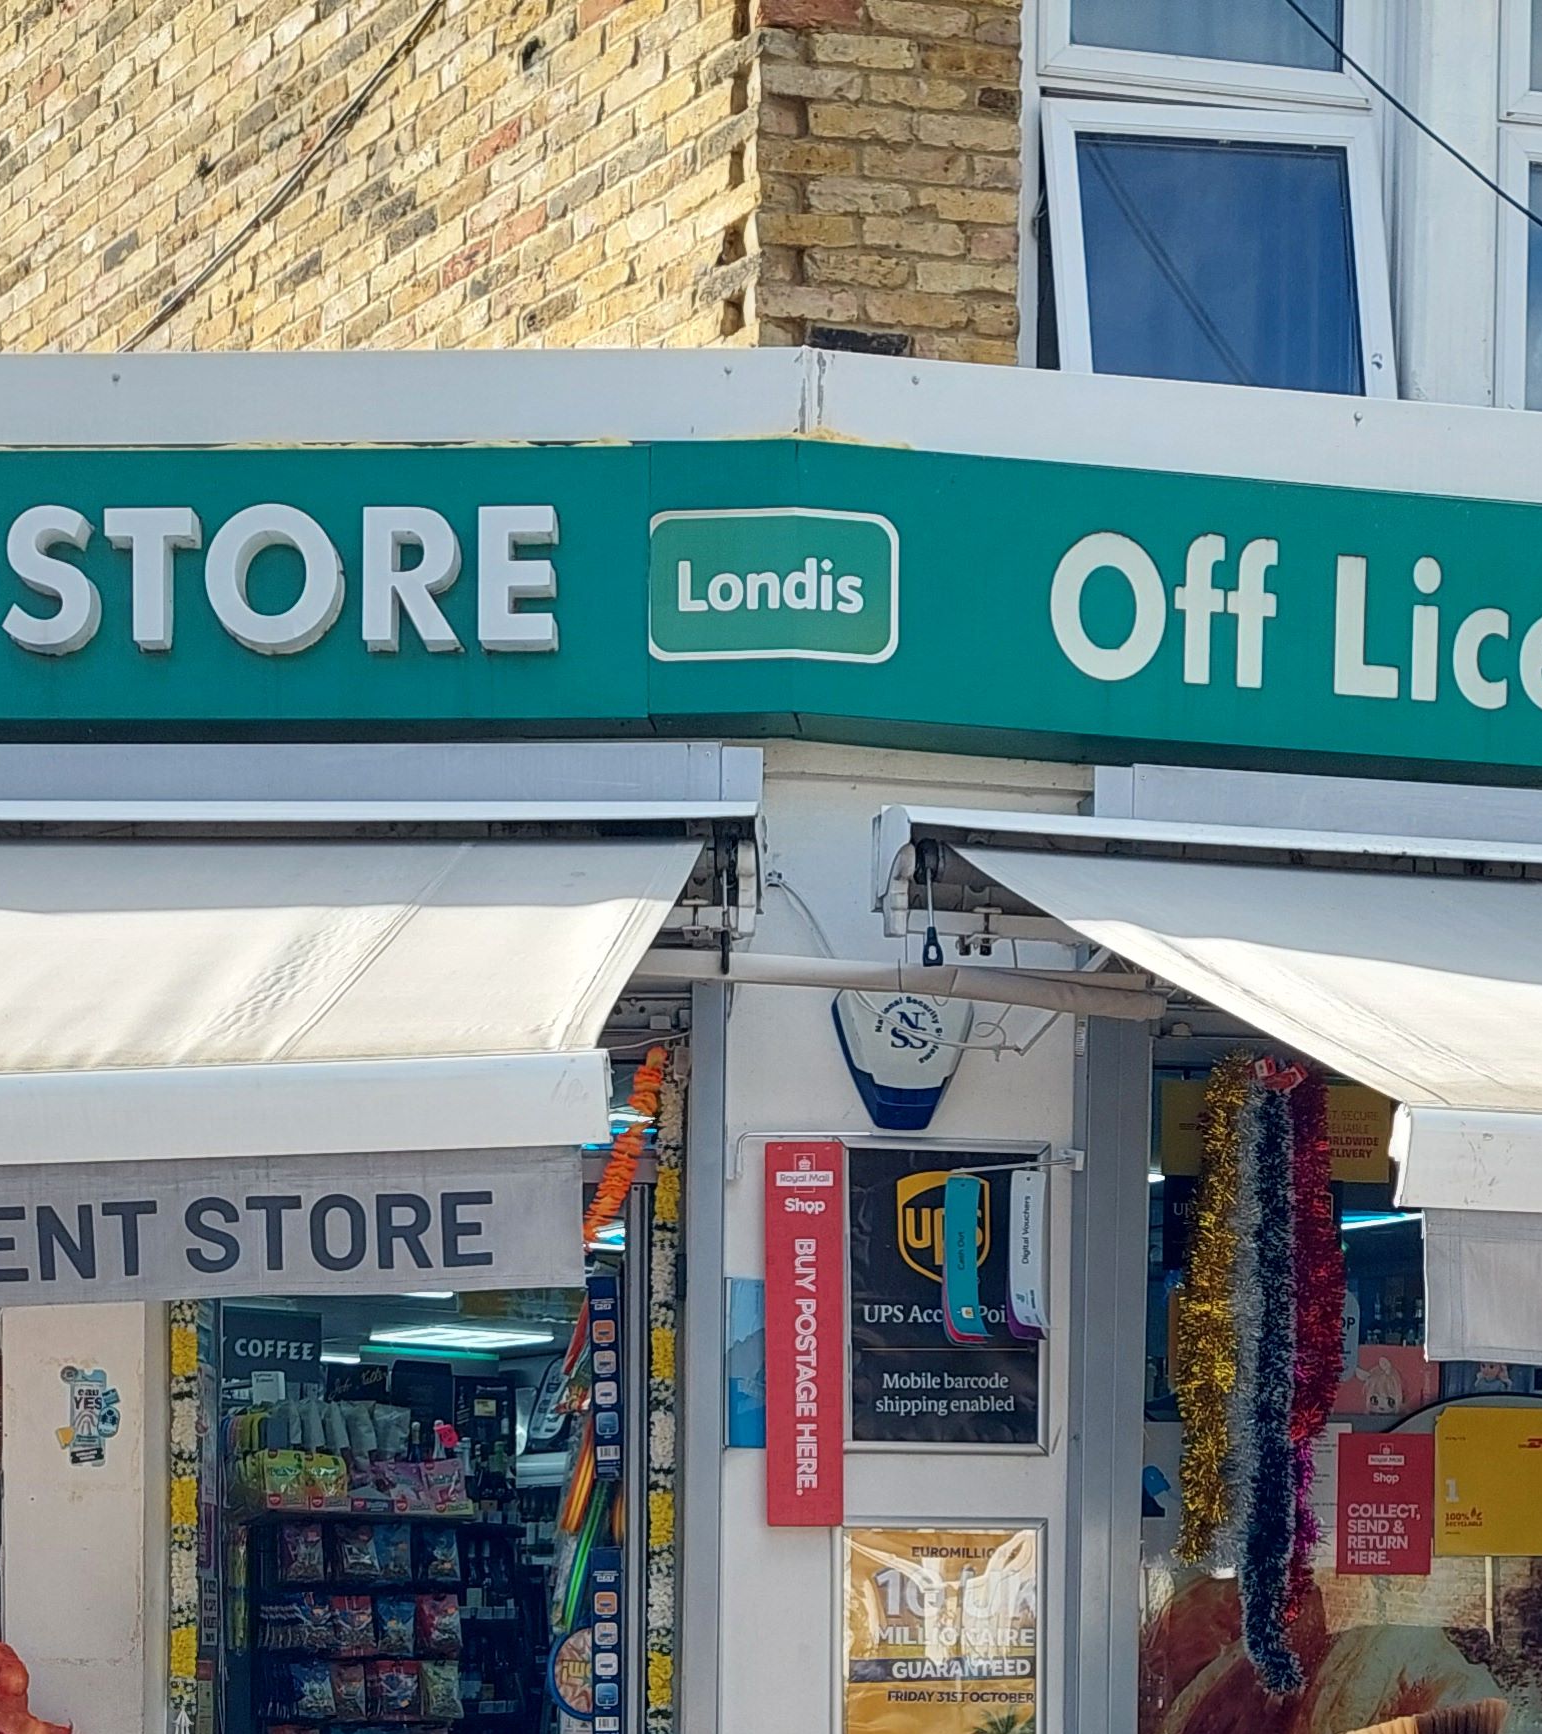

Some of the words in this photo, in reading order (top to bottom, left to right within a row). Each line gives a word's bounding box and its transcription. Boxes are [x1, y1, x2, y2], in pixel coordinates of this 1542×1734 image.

[3, 502, 560, 657] STORE
[674, 556, 867, 618] Londis
[1050, 531, 1279, 688] Off
[779, 1173, 807, 1184] Royal
[808, 1173, 830, 1183] Mail
[784, 1198, 826, 1214] Shop
[1021, 1195, 1032, 1237] Vouchers
[184, 1191, 494, 1274] STORE
[1021, 1238, 1032, 1265] Digital
[794, 1239, 817, 1292] BUY
[863, 1304, 904, 1323] UPS
[234, 1337, 315, 1360] COFFEE
[795, 1299, 818, 1418] POSTAGE
[882, 1373, 942, 1390] Mobile
[944, 1373, 1010, 1390] barcode
[73, 1396, 103, 1410] YES
[876, 1397, 949, 1417] shipping
[950, 1396, 1015, 1412] enabled
[795, 1423, 818, 1496] HERE.
[1372, 1472, 1400, 1485] Shop
[1445, 1477, 1460, 1504] 1
[1347, 1503, 1421, 1521] COLLECT,
[1445, 1512, 1471, 1522] 100%
[1347, 1519, 1390, 1534] SEND
[1392, 1519, 1405, 1534] &
[1347, 1535, 1408, 1550] RETURN
[1347, 1551, 1391, 1565] HERE.
[891, 1658, 1032, 1680] GUARANTEED
[887, 1691, 935, 1703] FRIDAY
[969, 1690, 1035, 1704] OCTOBER
